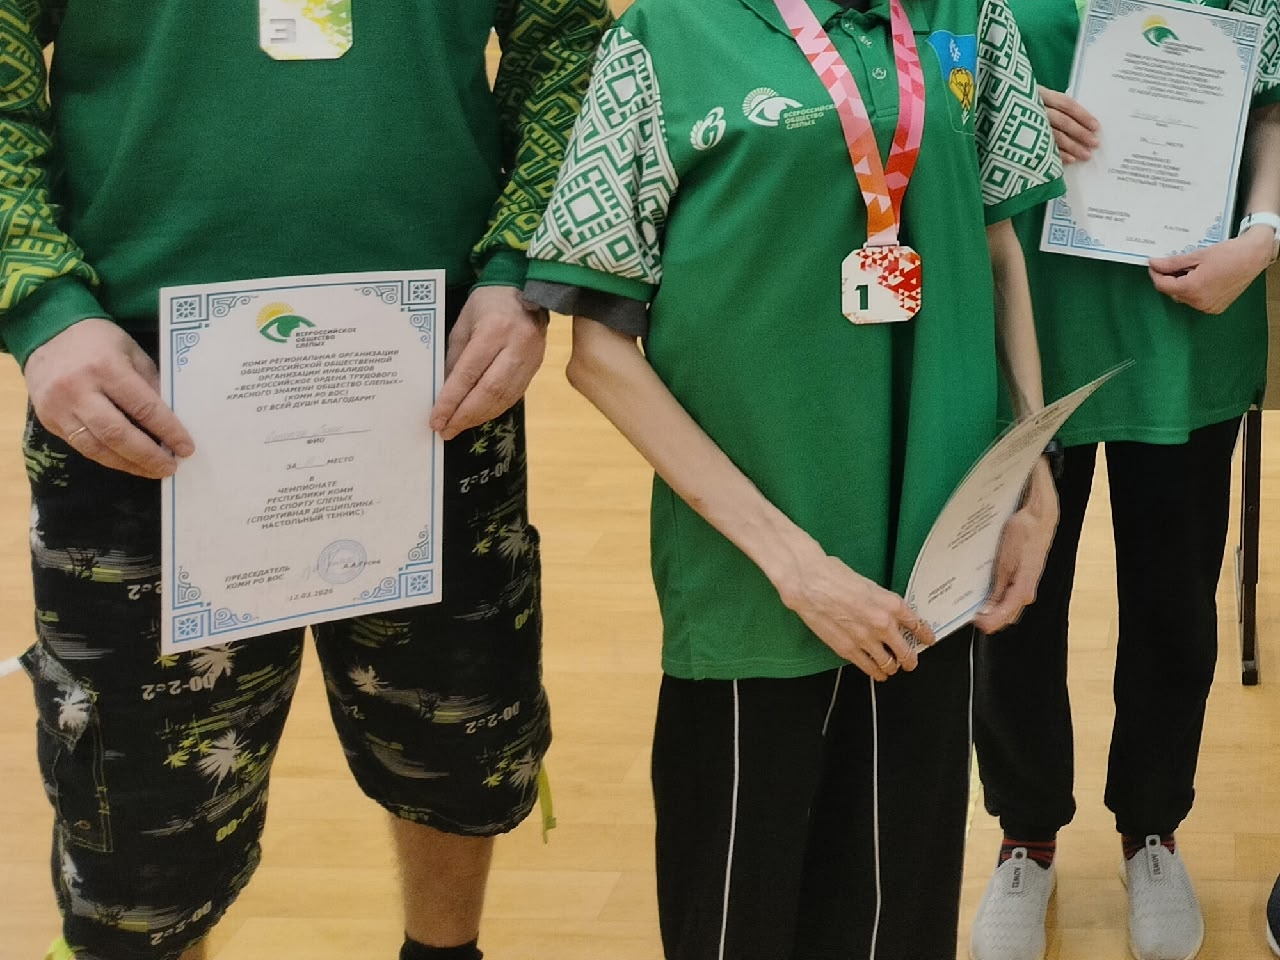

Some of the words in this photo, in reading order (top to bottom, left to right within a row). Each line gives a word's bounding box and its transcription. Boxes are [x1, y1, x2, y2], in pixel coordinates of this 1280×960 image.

[785, 112, 824, 124] ОБЩЕСТВО
[786, 120, 815, 129] СЛЕПЫХ
[855, 284, 869, 310] 1
[295, 328, 356, 337] ВСЕРОССИЙСКОЕ
[296, 335, 335, 343] ОБЩЕСТВО
[241, 362, 322, 375] ОБЩЕРОССИЙСКОЙ
[324, 357, 392, 367] ОБЩЕСТВЕННОЙ
[243, 359, 267, 367] КОМИ
[270, 354, 336, 364] РЕГИОНАЛЬНАЯ
[339, 350, 399, 358] ОРГАНИЗАЦИЯ
[258, 371, 321, 381] ОРГАНИЗАЦИИ
[323, 366, 374, 374] ИНВАЛИДОВ
[227, 390, 271, 400] КРАСНОГО
[274, 386, 314, 394] ЗНАМЕНИ
[317, 381, 362, 389] ОБЩЕСТВО
[284, 393, 312, 401] (КОМИ
[270, 402, 291, 410] ВСЕЙ
[293, 400, 319, 409] ДУШИ
[322, 395, 376, 405] БЛАГОДАРИТ
[278, 481, 337, 493] ЧЕМПИОНАТЕ
[267, 490, 325, 504] РЕСПУБЛИКИ
[328, 487, 353, 495] КОМИ
[280, 500, 314, 510] СПОРТУ
[317, 495, 353, 505] СЛЕПЫХ
[247, 509, 310, 525] (СПОРТИВНАЯ
[312, 500, 373, 514] ДИСЦИПЛИНА
[262, 515, 323, 529] НАСТОЛЬНЫЙ
[327, 510, 364, 519] ТЕННИС)
[225, 566, 290, 582] ПРЕДСЕДАТЕЛЬ
[226, 581, 251, 590] КОМИ
[268, 574, 284, 582] ВОС
